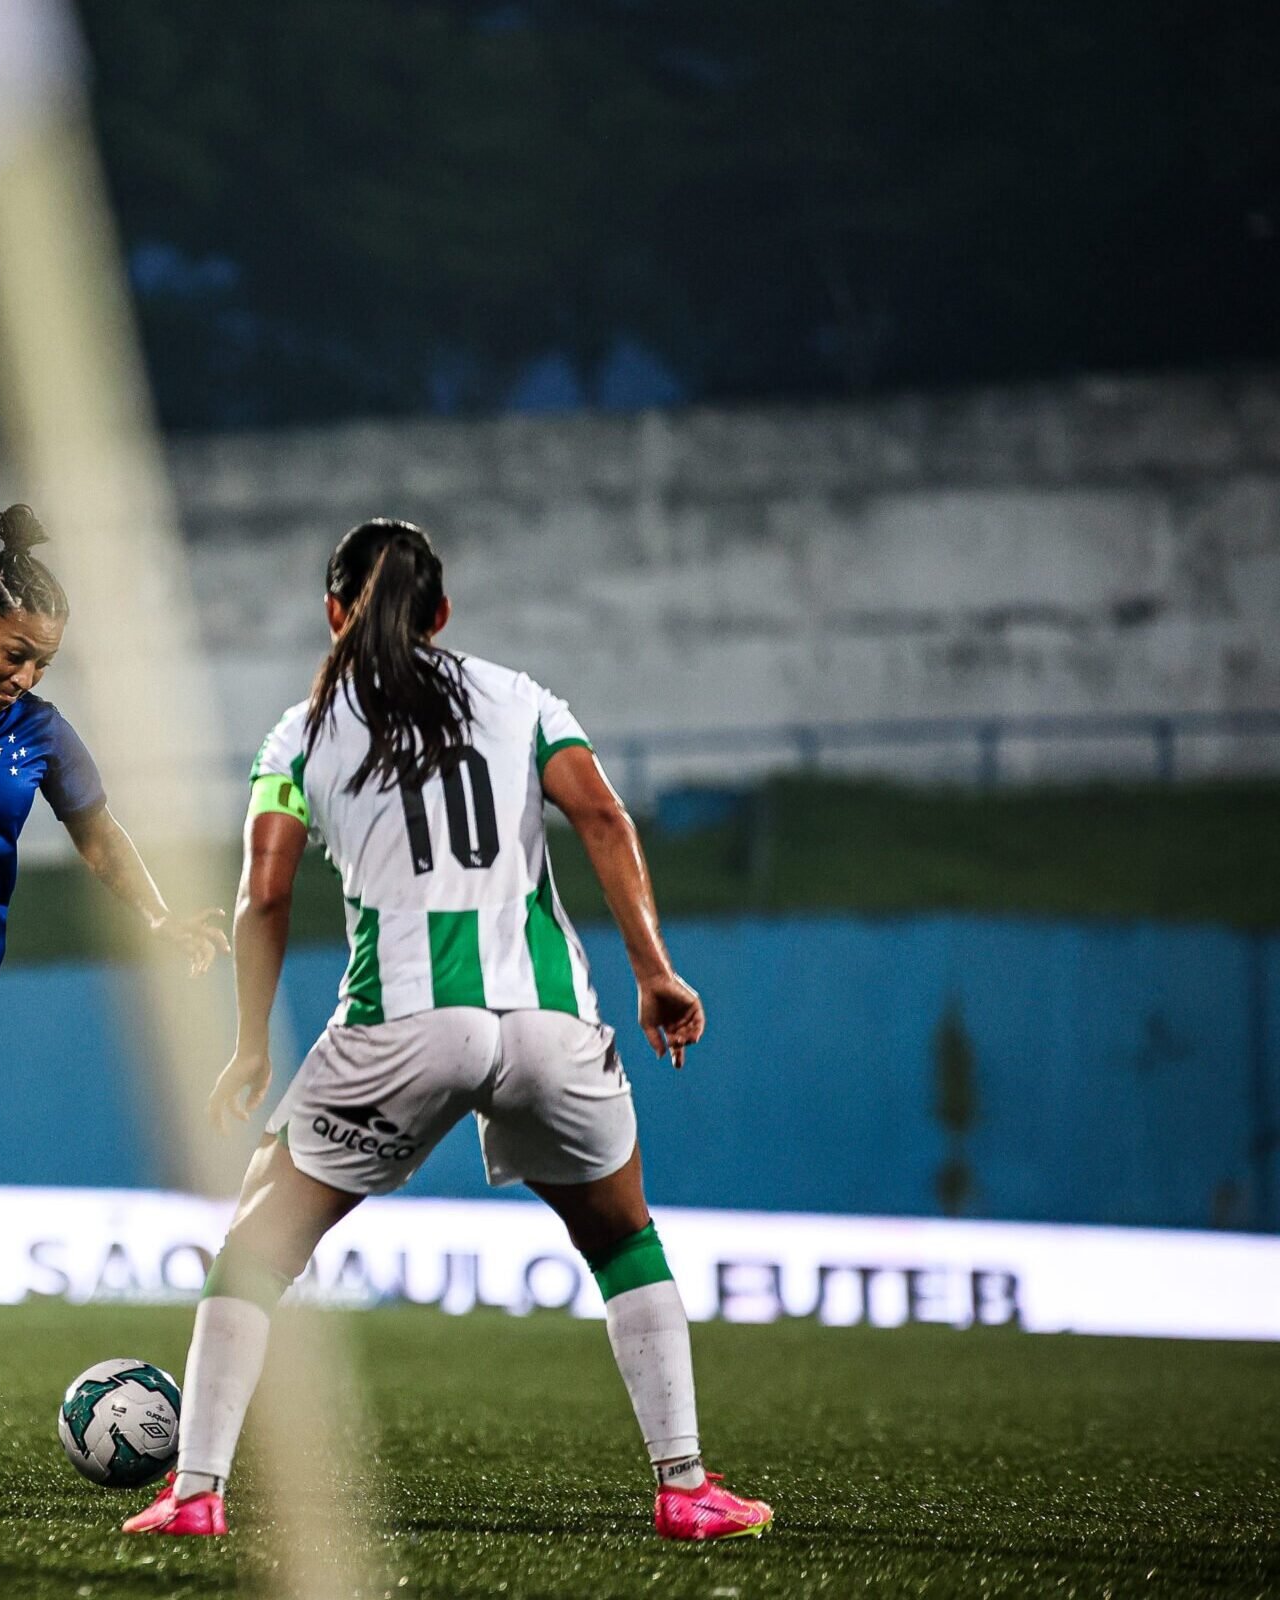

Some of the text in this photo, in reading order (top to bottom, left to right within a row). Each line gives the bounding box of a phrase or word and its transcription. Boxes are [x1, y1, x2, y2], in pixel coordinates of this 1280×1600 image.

[397, 744, 500, 876] 10
[311, 1115, 420, 1162] auteco
[145, 1410, 172, 1425] umbro
